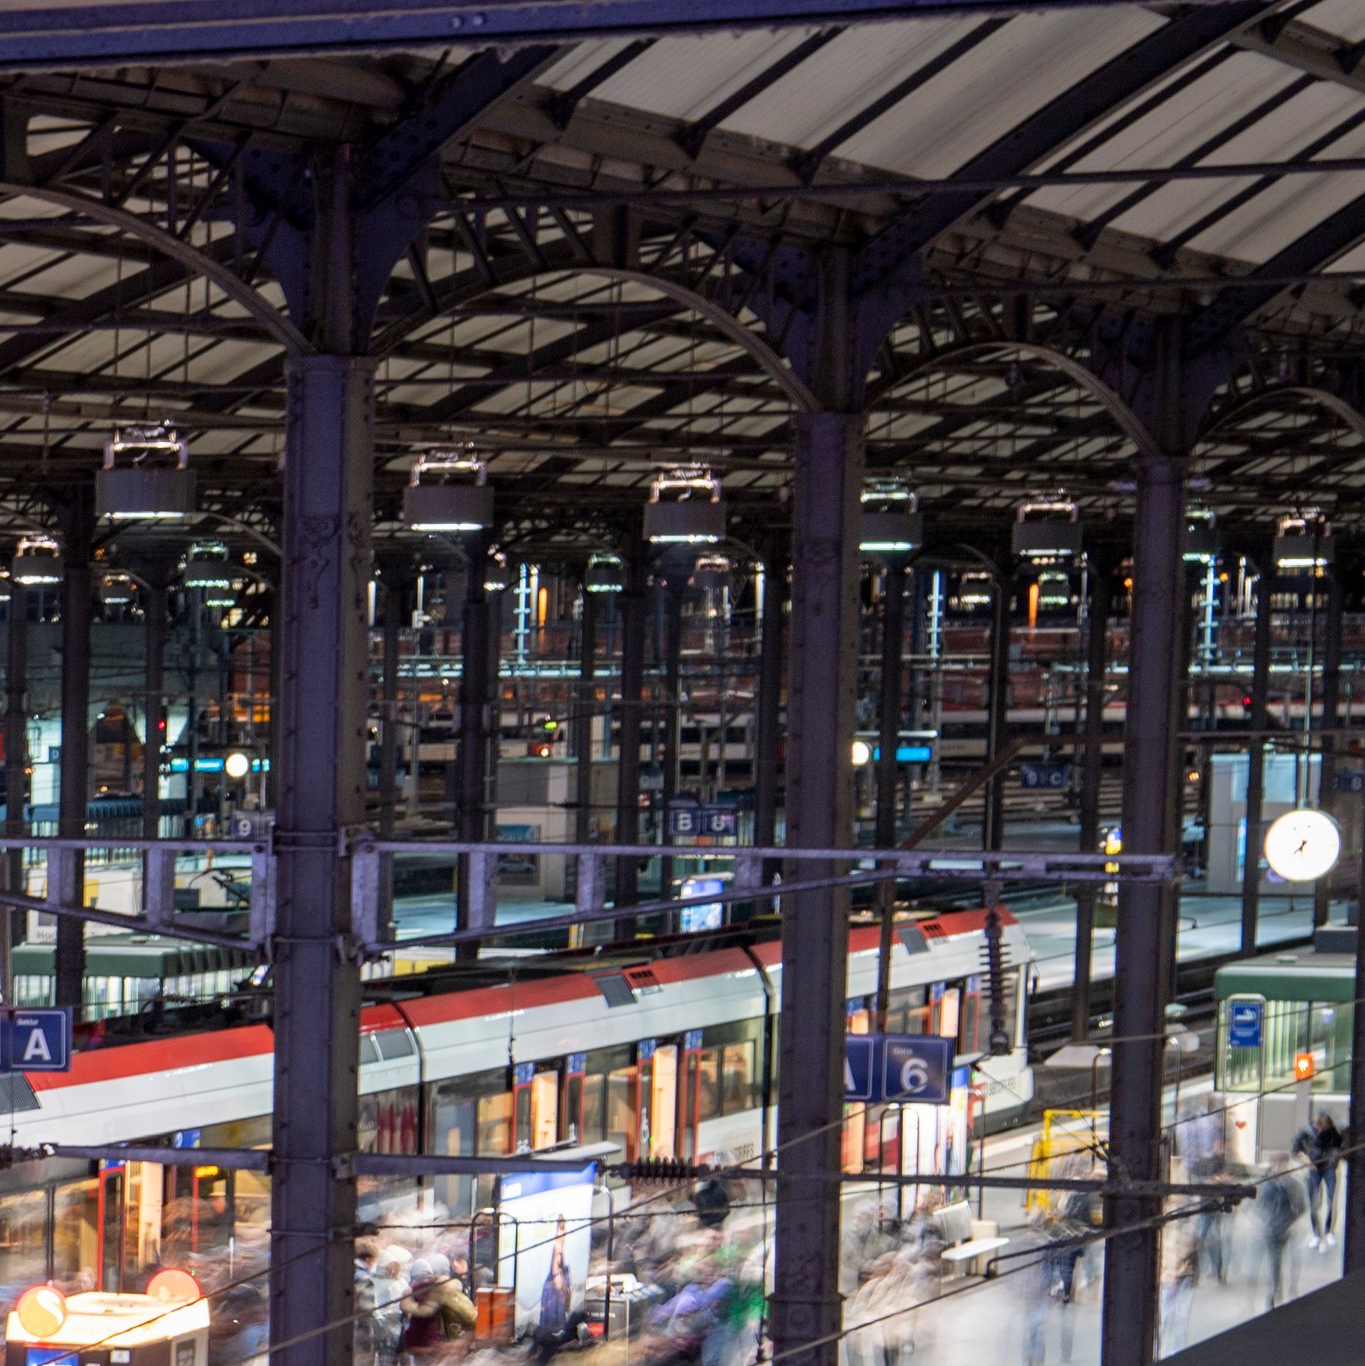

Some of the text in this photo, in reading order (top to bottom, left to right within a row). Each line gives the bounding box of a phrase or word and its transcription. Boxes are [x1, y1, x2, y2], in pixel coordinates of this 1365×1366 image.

[238, 819, 252, 836] 9
[677, 813, 692, 830] B
[23, 1028, 51, 1061] A
[900, 1058, 928, 1093] 6
